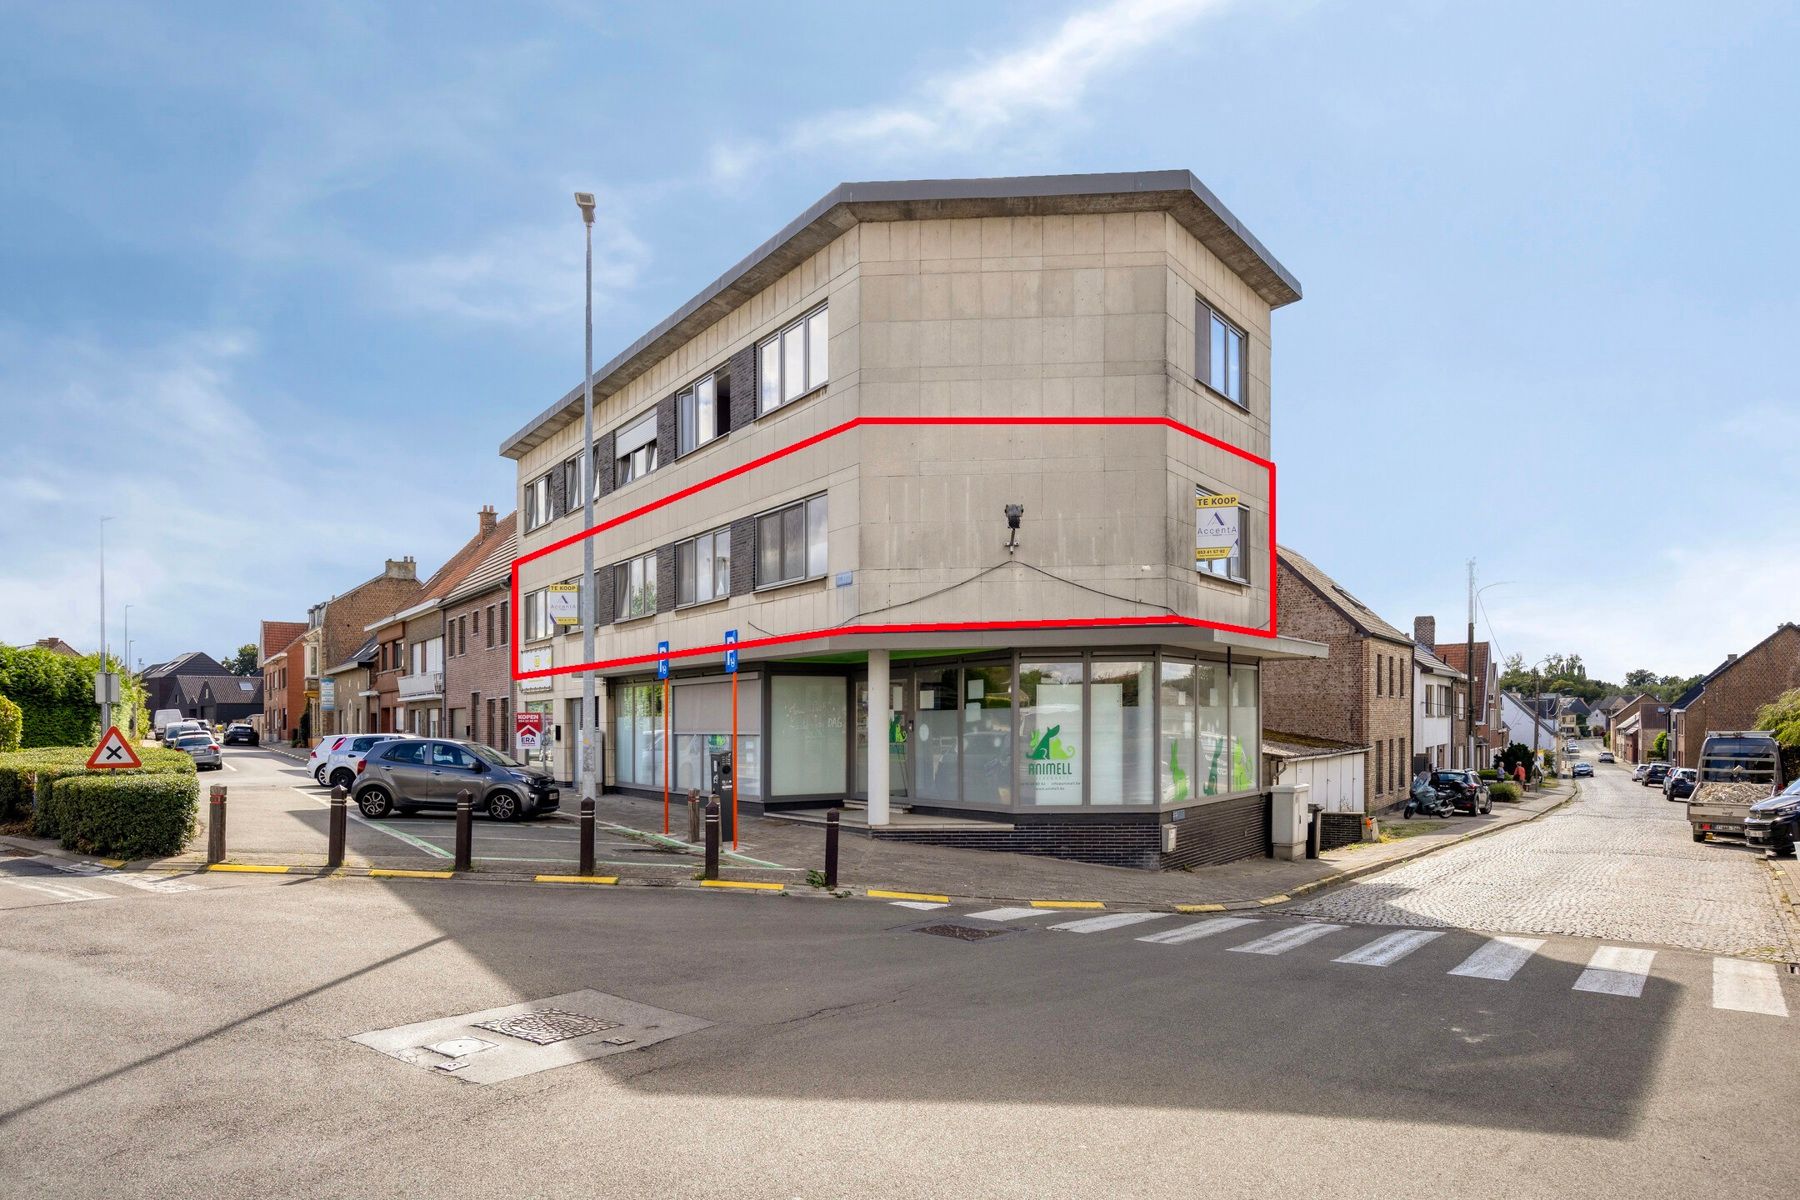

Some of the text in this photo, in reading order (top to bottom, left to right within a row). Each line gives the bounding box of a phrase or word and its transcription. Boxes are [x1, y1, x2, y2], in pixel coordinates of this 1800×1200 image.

[1197, 497, 1236, 506] TE KOOP
[1028, 762, 1073, 775] ANIMELL
